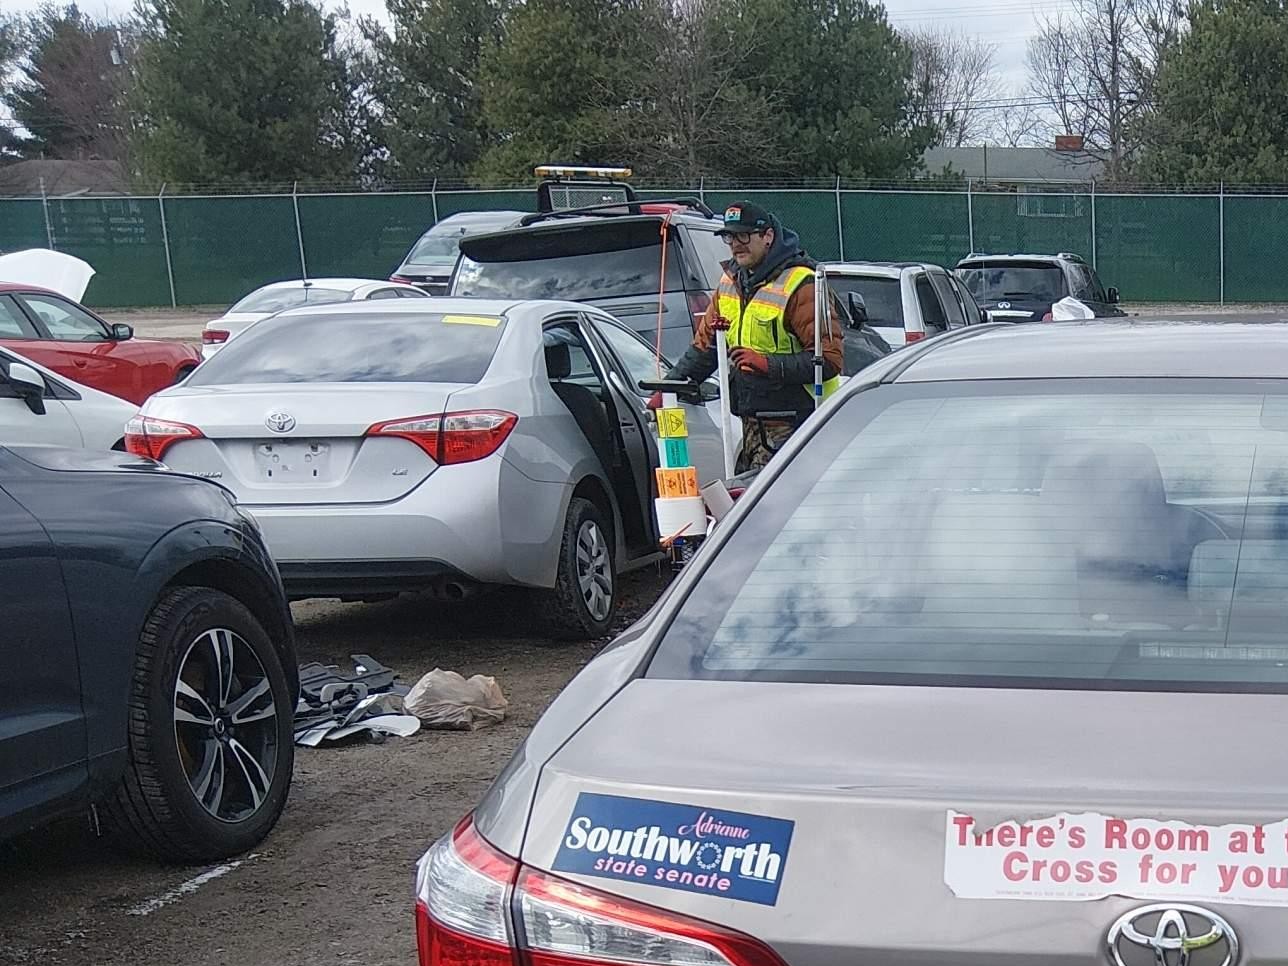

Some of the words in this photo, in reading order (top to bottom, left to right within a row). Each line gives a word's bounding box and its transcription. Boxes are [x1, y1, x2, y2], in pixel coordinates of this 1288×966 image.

[678, 811, 750, 840] Adrienne
[1105, 819, 1209, 852] Room
[1228, 824, 1265, 854] at
[566, 816, 782, 881] Southworth
[593, 856, 648, 876] state
[655, 866, 731, 891] senate
[1002, 851, 1118, 883] Cross
[1139, 854, 1197, 884] for
[1217, 873, 1288, 892] you
